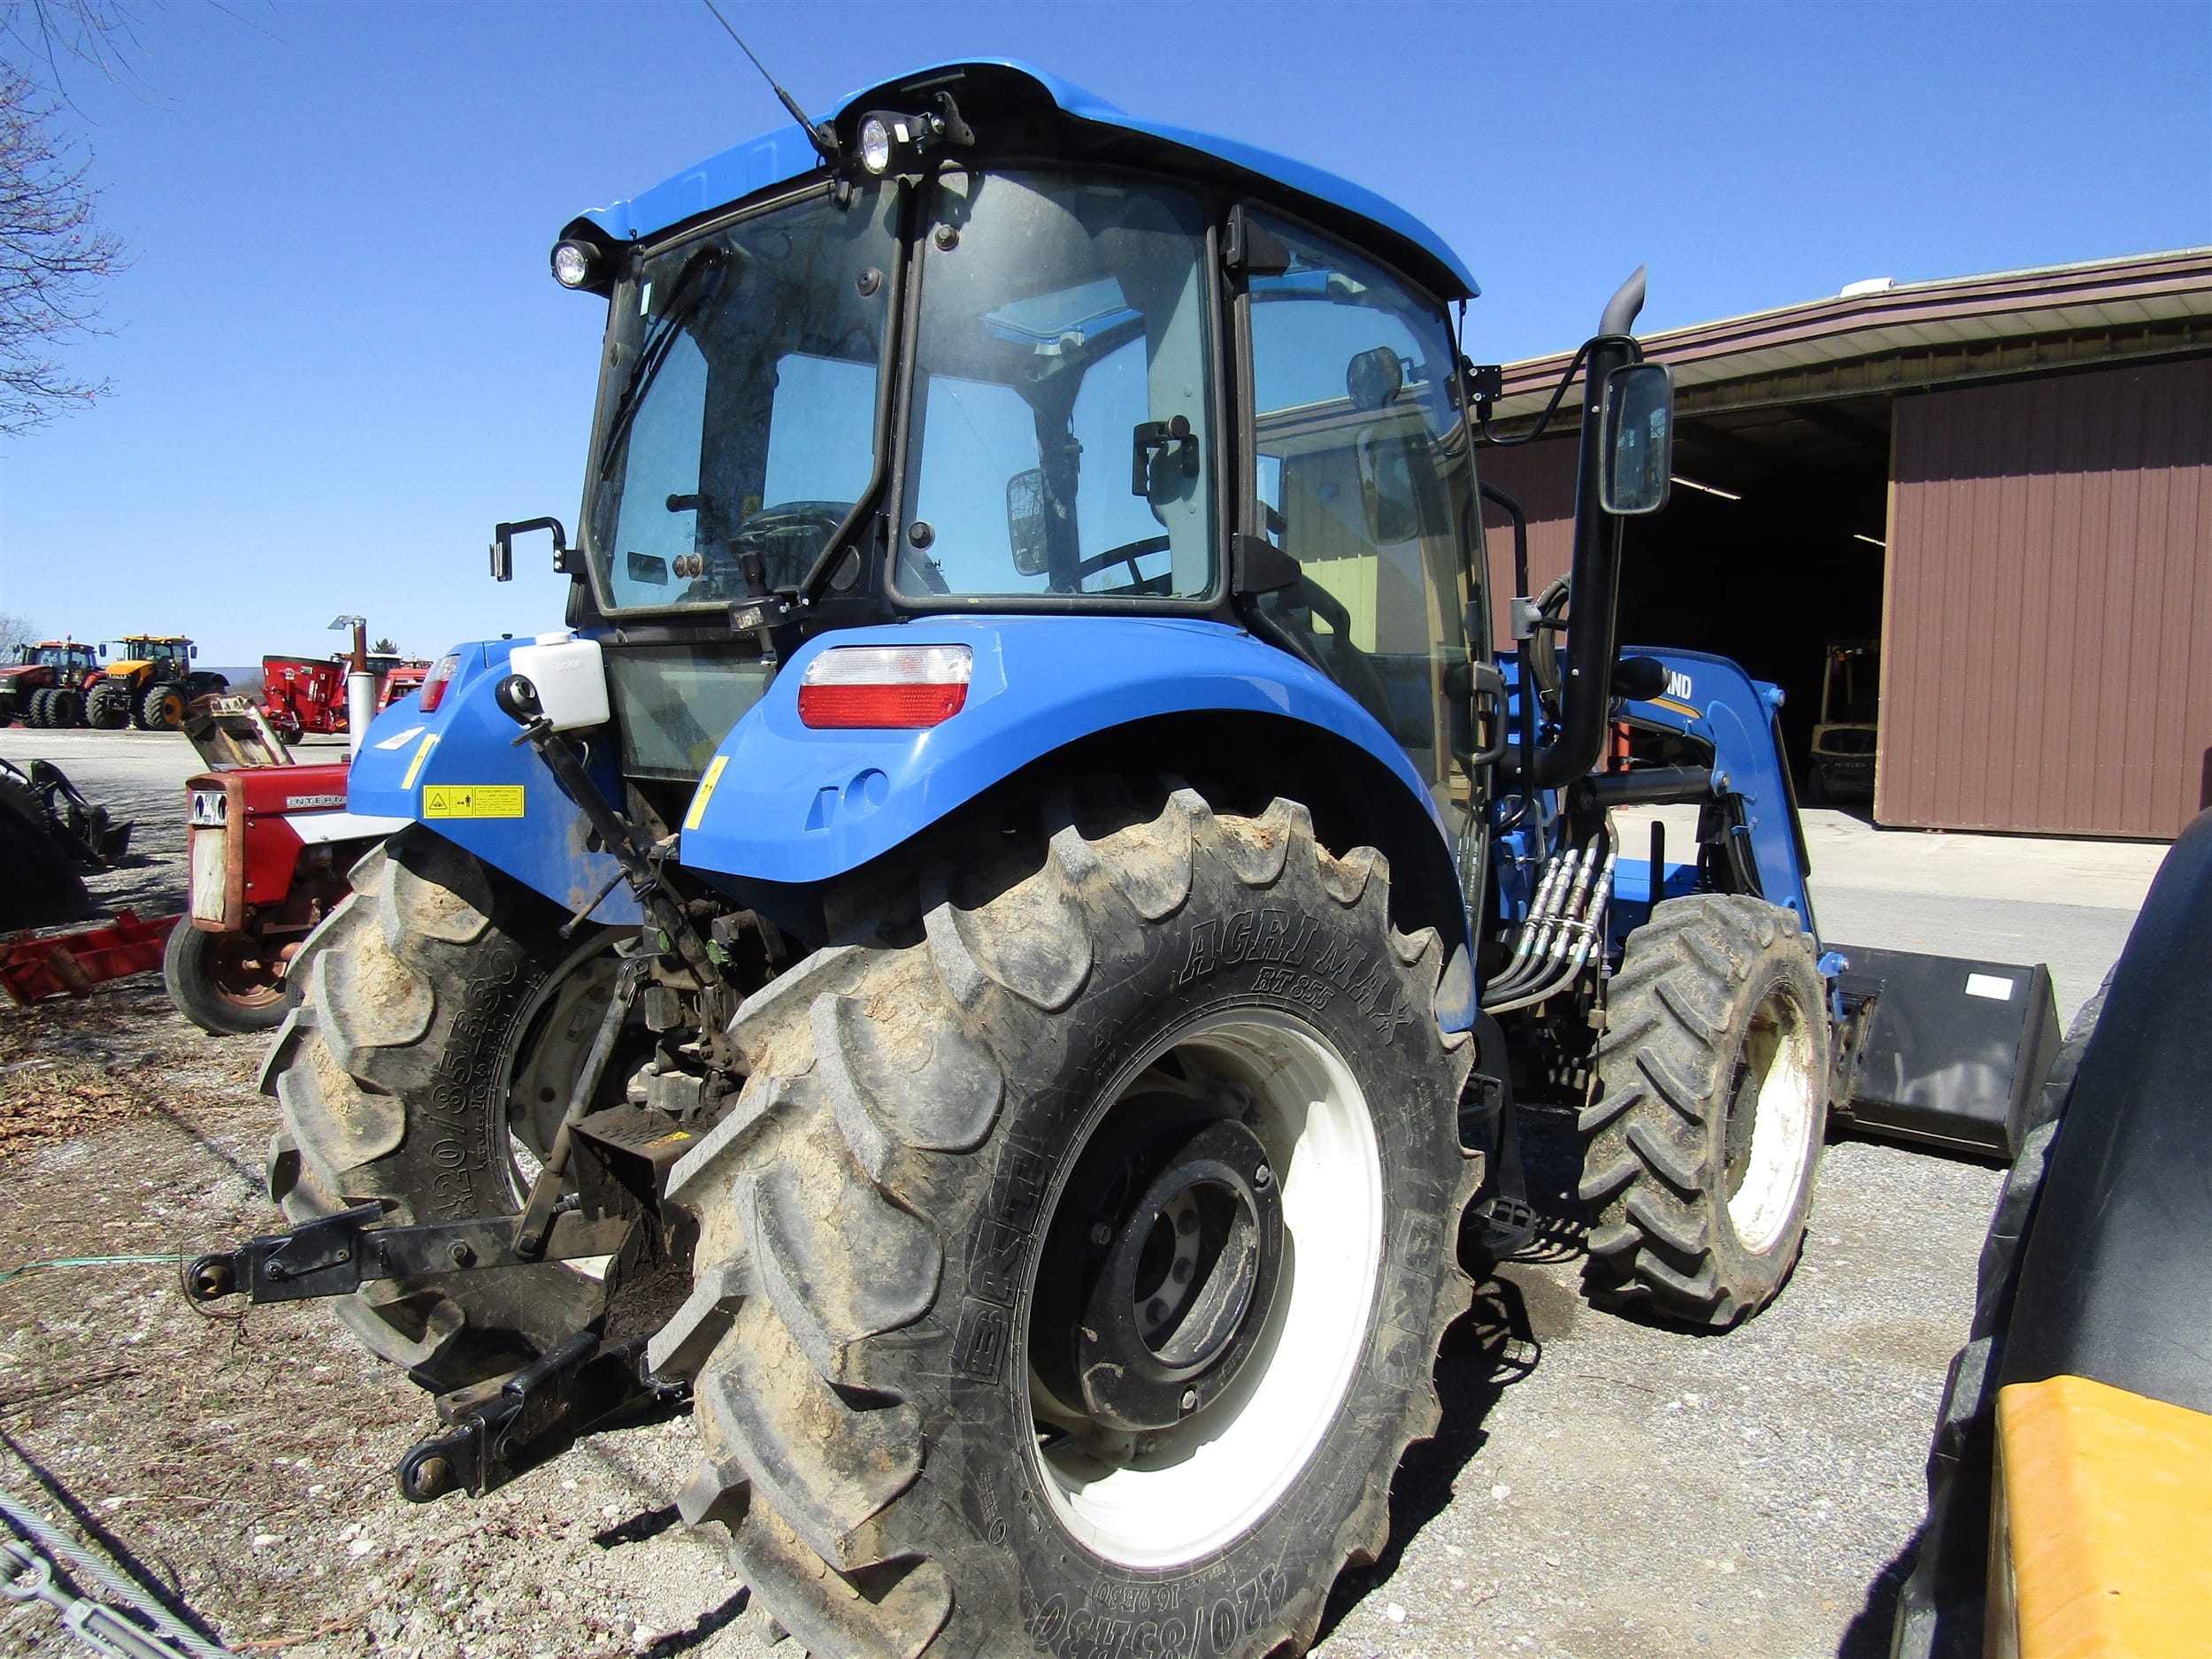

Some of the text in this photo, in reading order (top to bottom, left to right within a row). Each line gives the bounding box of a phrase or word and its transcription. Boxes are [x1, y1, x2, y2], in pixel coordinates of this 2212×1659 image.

[289, 796, 343, 805] INTERN
[1252, 966, 1335, 1010] RT 855
[949, 1141, 1044, 1386] BKT
